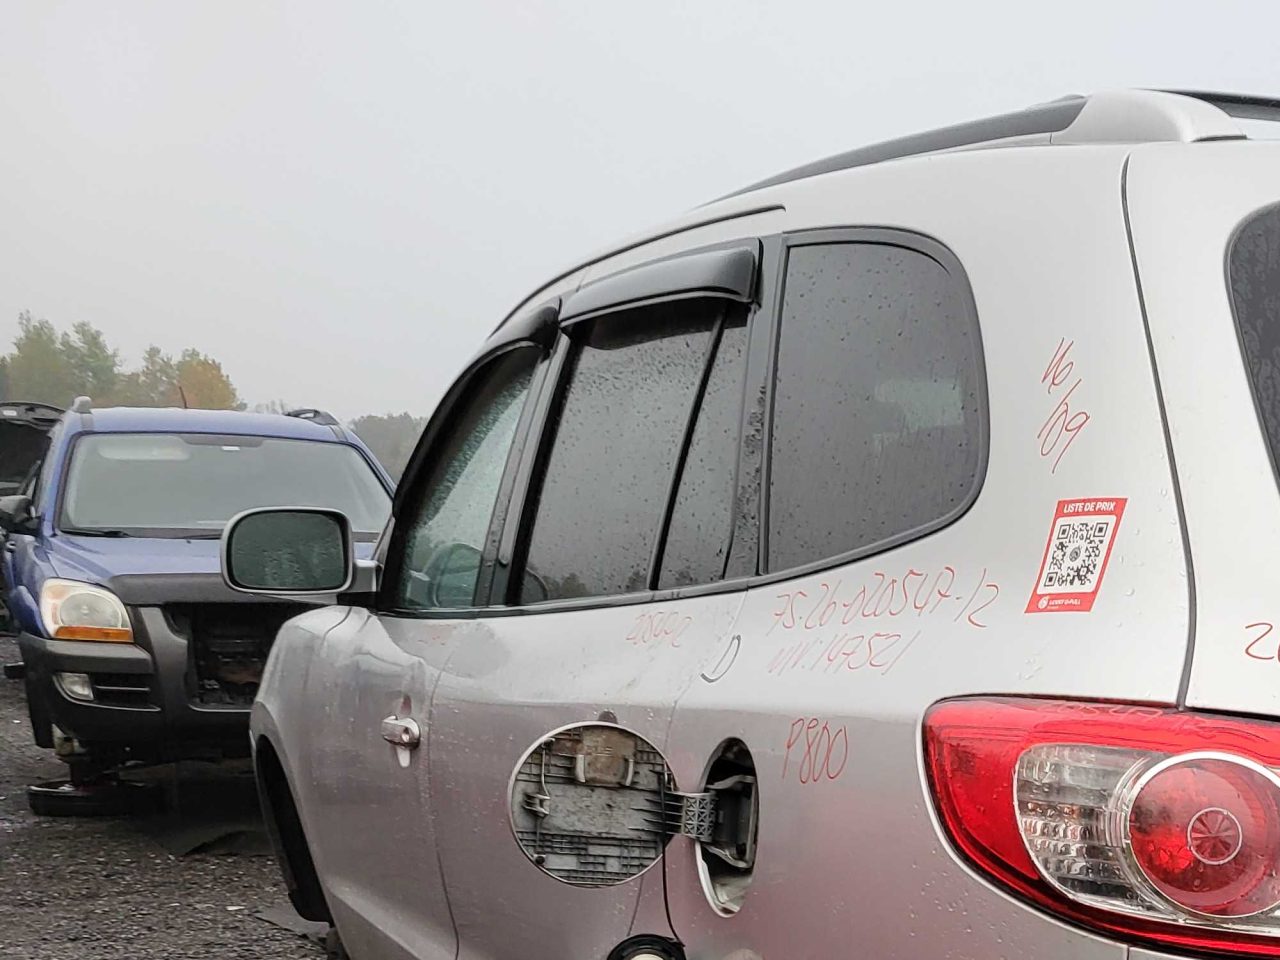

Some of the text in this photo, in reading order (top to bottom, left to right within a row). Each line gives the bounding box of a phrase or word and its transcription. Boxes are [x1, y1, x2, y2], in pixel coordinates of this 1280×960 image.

[1063, 502, 1116, 513] LISTE DE PRIX
[781, 717, 849, 784] P800
